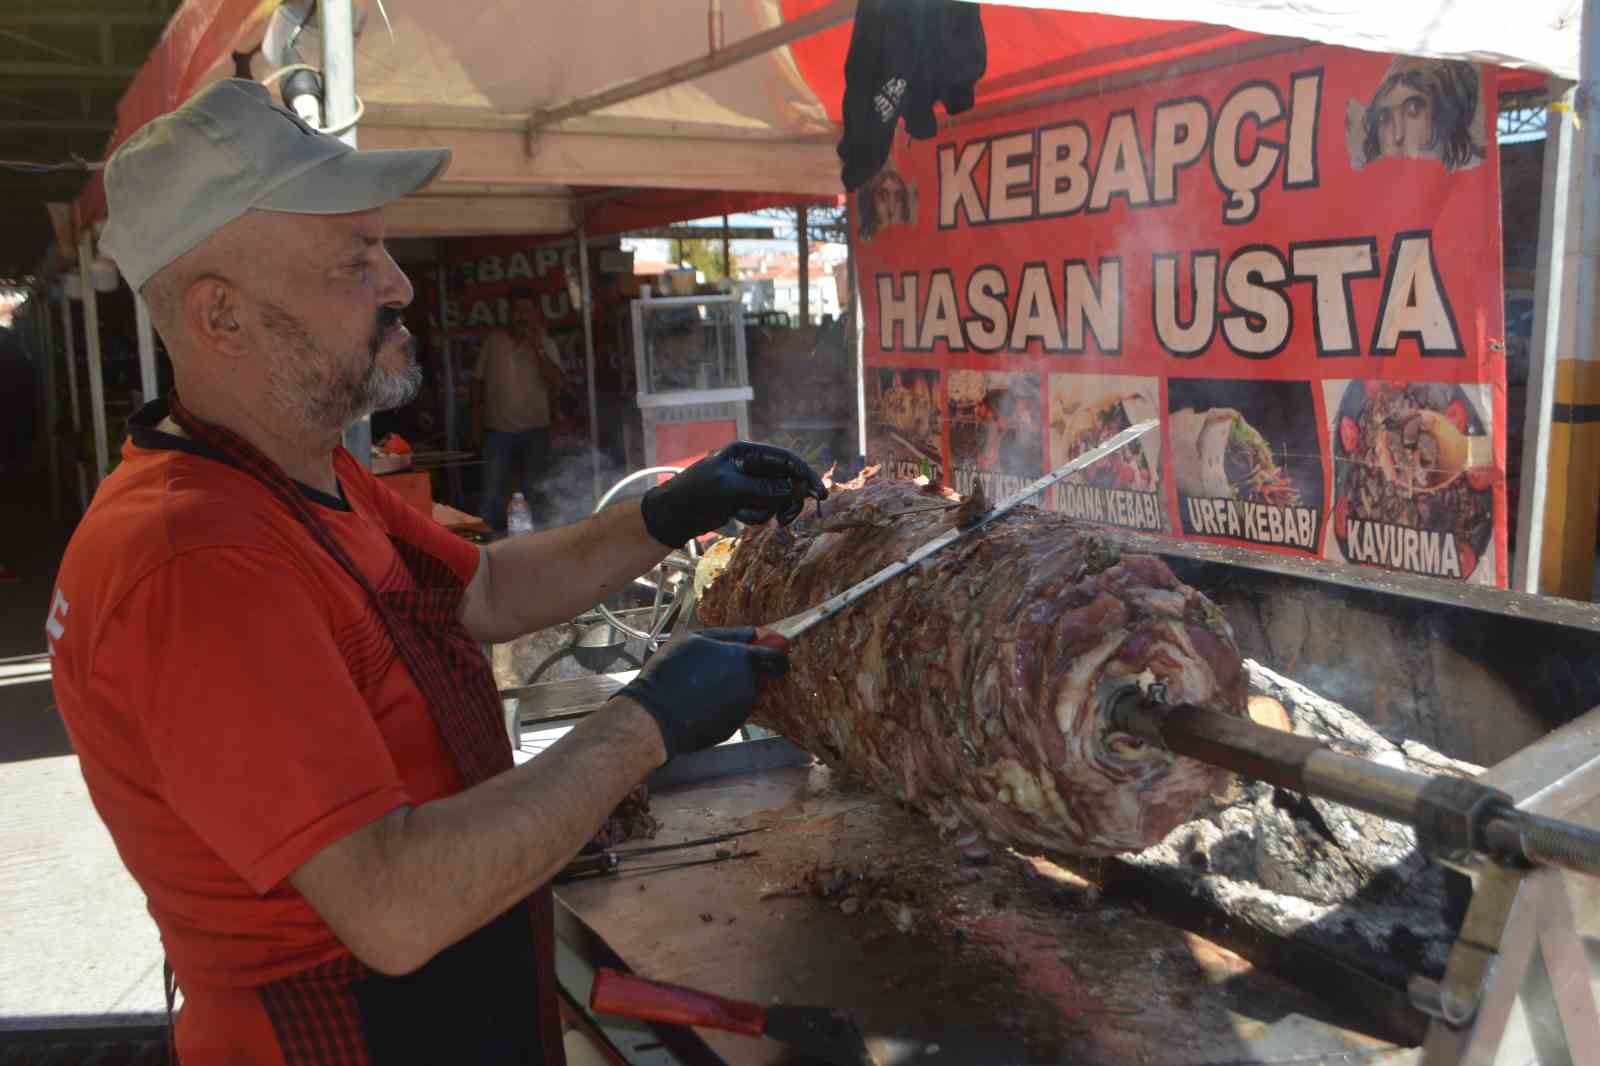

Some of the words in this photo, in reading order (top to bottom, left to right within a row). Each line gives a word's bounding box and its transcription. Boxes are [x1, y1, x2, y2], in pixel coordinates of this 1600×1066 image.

[937, 67, 1323, 229] KEBAPÇI
[876, 257, 1123, 353] HASAN
[1152, 230, 1466, 360] USTA
[1187, 496, 1241, 536] URFA
[1243, 502, 1317, 548] KEBABI
[1347, 518, 1461, 578] KAVURMA
